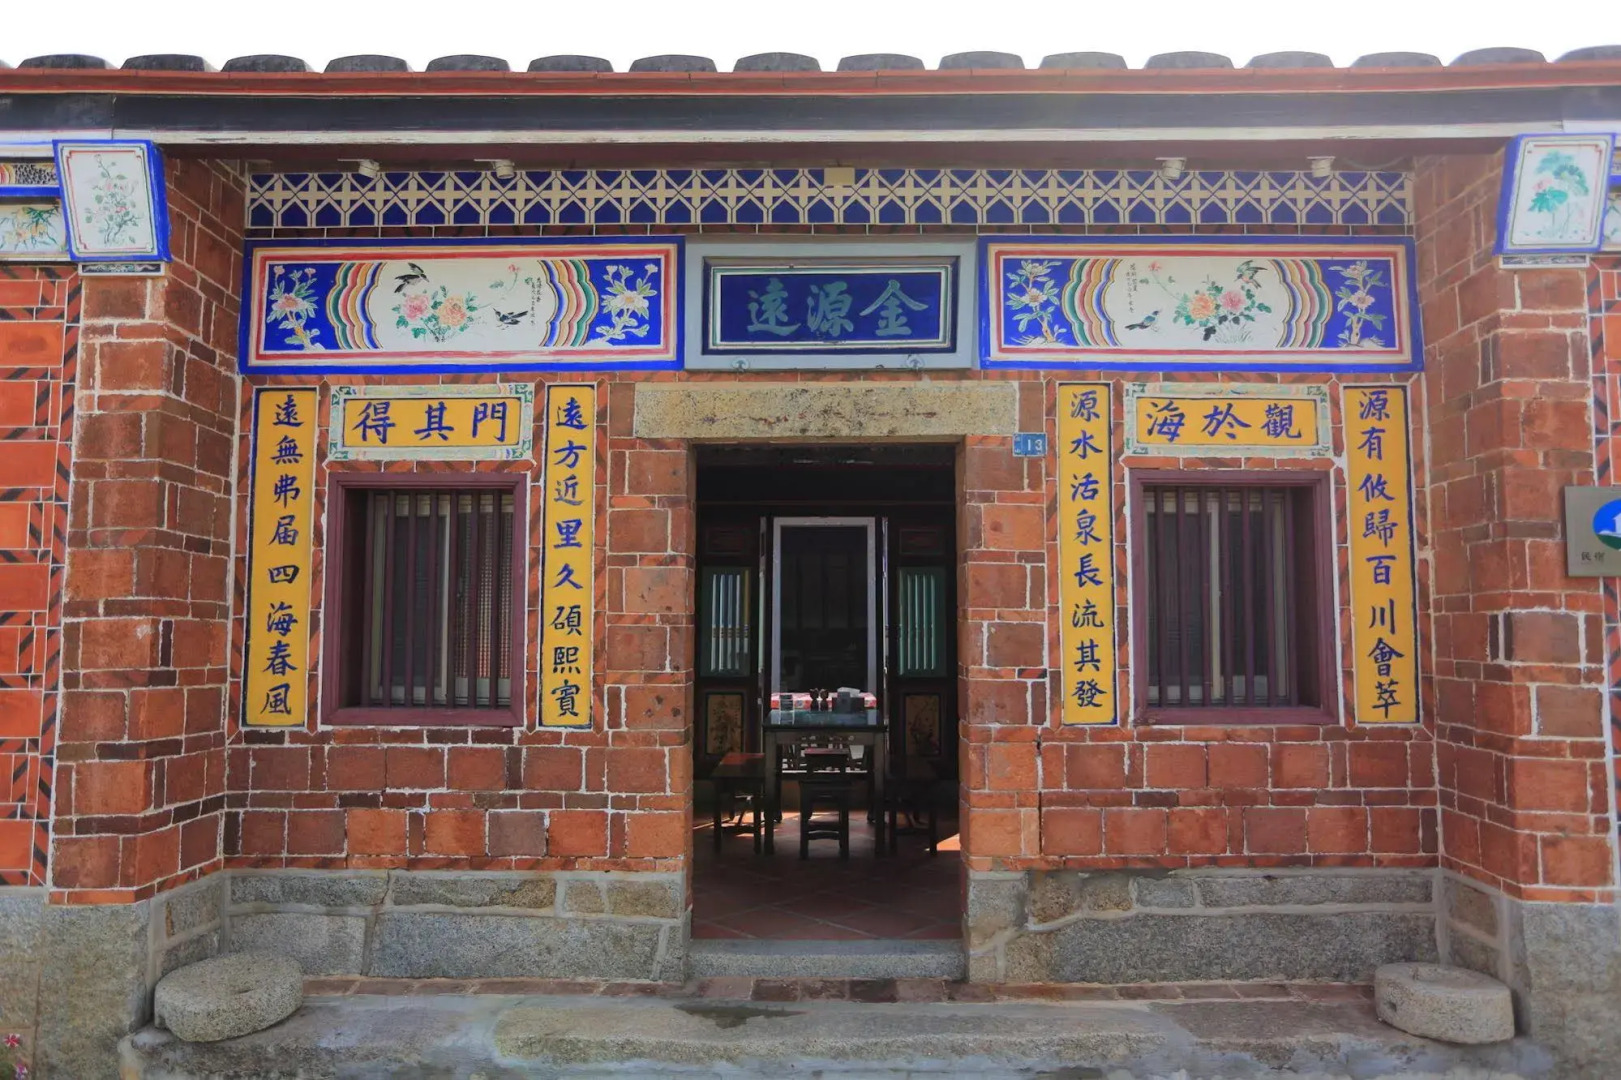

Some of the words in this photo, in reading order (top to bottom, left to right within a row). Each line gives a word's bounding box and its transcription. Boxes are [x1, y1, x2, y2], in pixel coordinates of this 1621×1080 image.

[1069, 390, 1107, 707] 源水活泉長流其發
